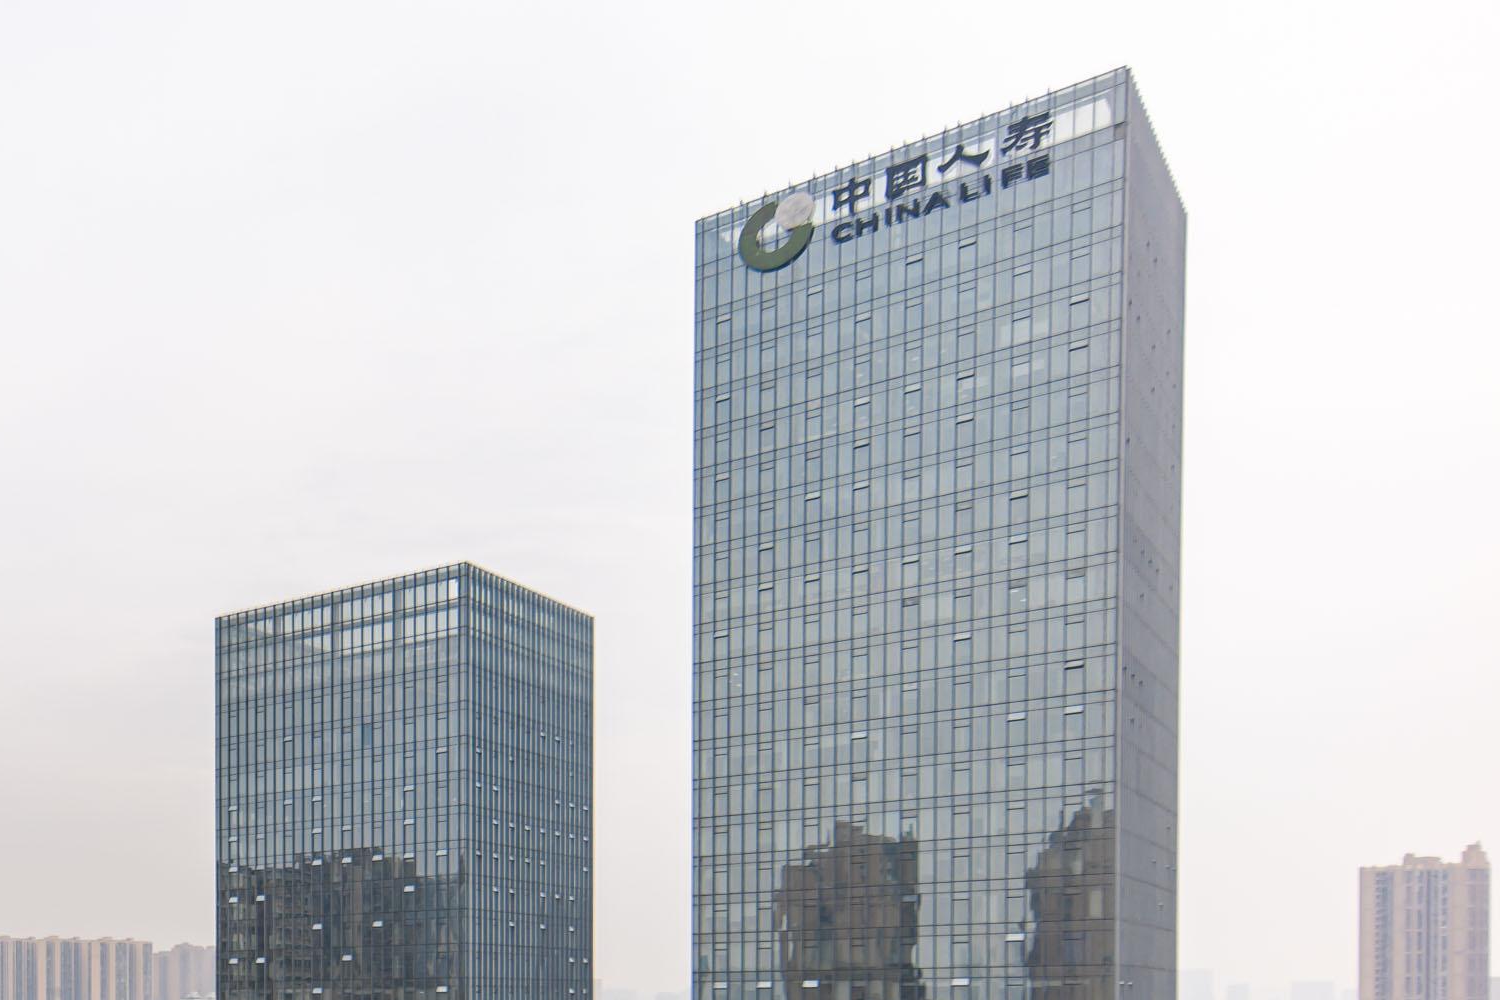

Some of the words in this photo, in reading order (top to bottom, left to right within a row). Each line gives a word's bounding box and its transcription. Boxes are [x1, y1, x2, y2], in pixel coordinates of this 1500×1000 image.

[831, 111, 1053, 216] 中国人寿
[832, 191, 950, 244] CHINA
[959, 154, 1050, 204] LIFE
